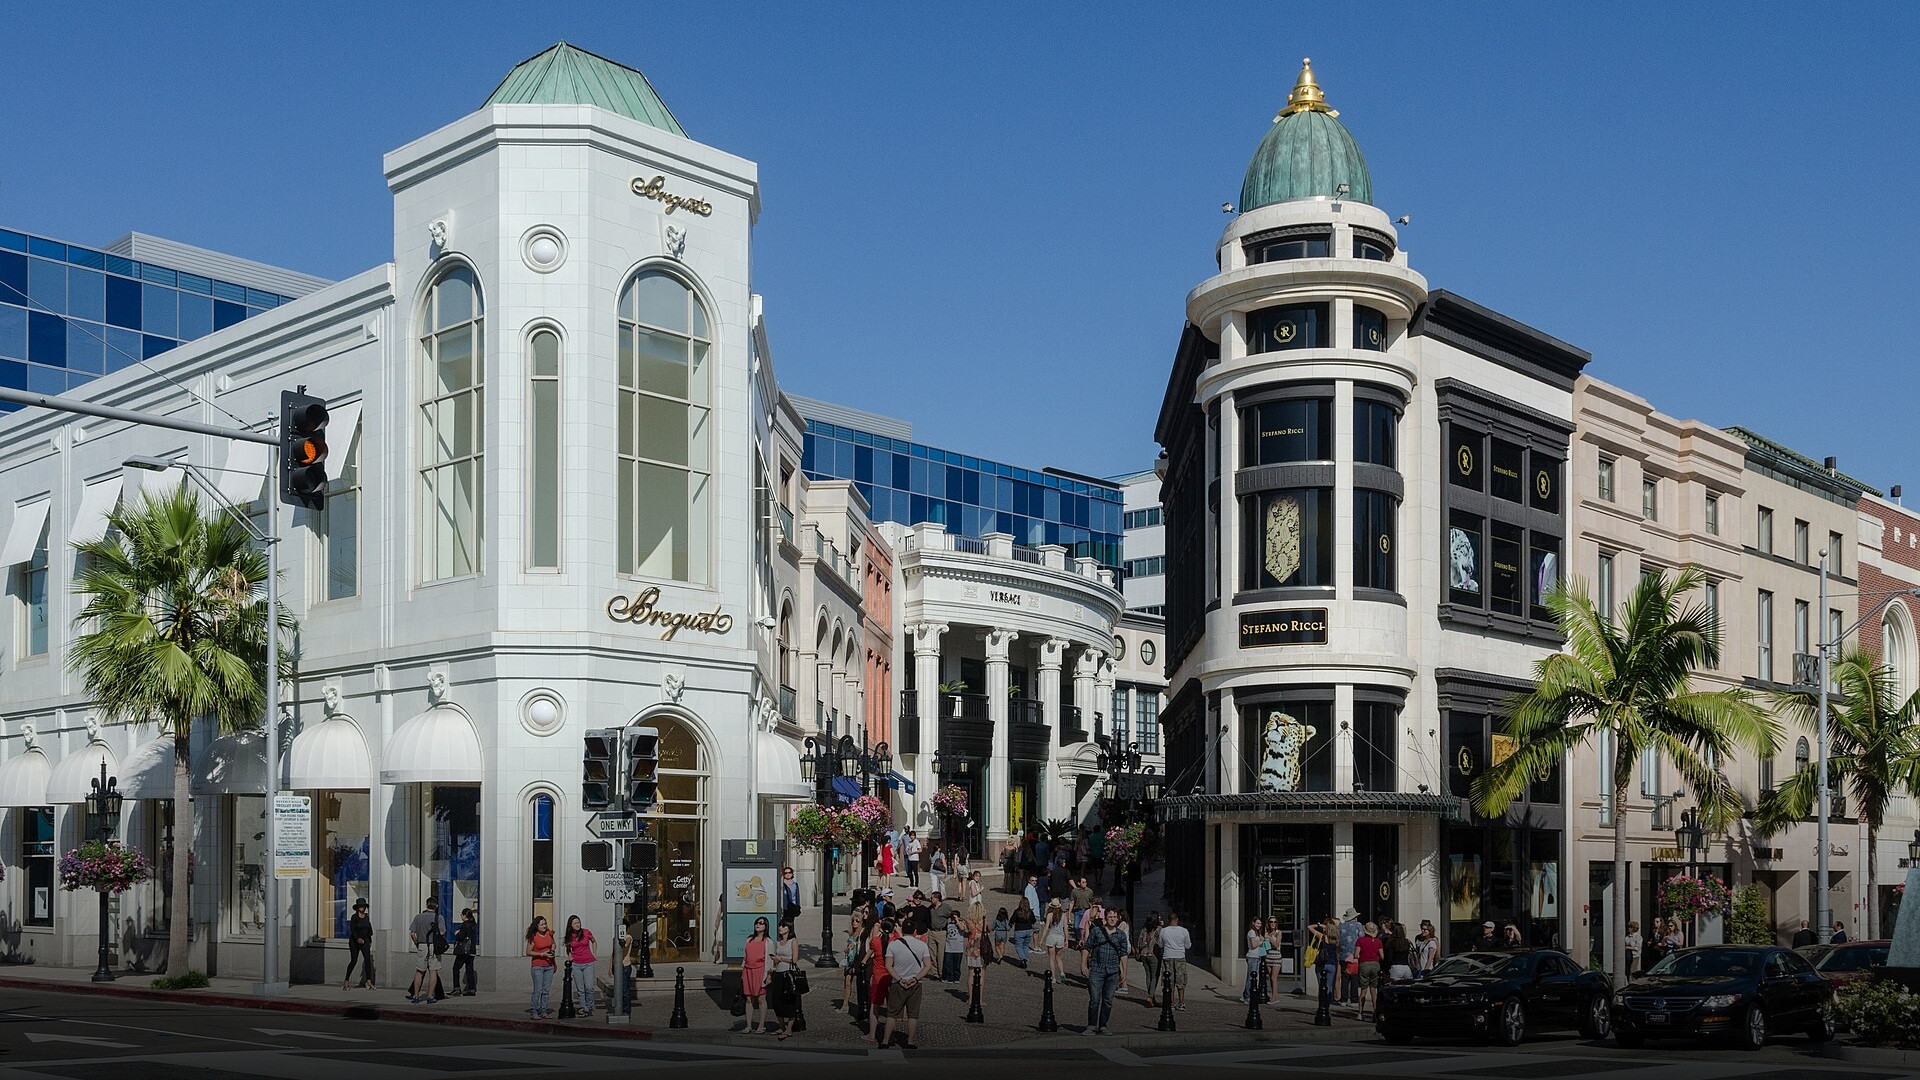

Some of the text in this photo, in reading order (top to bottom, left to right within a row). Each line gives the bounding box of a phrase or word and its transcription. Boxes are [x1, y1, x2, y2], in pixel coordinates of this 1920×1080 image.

[631, 176, 712, 217] Breguet
[1262, 429, 1286, 438] STEFANO
[990, 590, 1021, 605] VERSACE
[606, 587, 733, 641] Breguet
[1242, 620, 1323, 635] STEFANO RICCI
[600, 820, 631, 830] ONE WAY
[676, 876, 692, 885] Getty
[604, 889, 616, 900] OK
